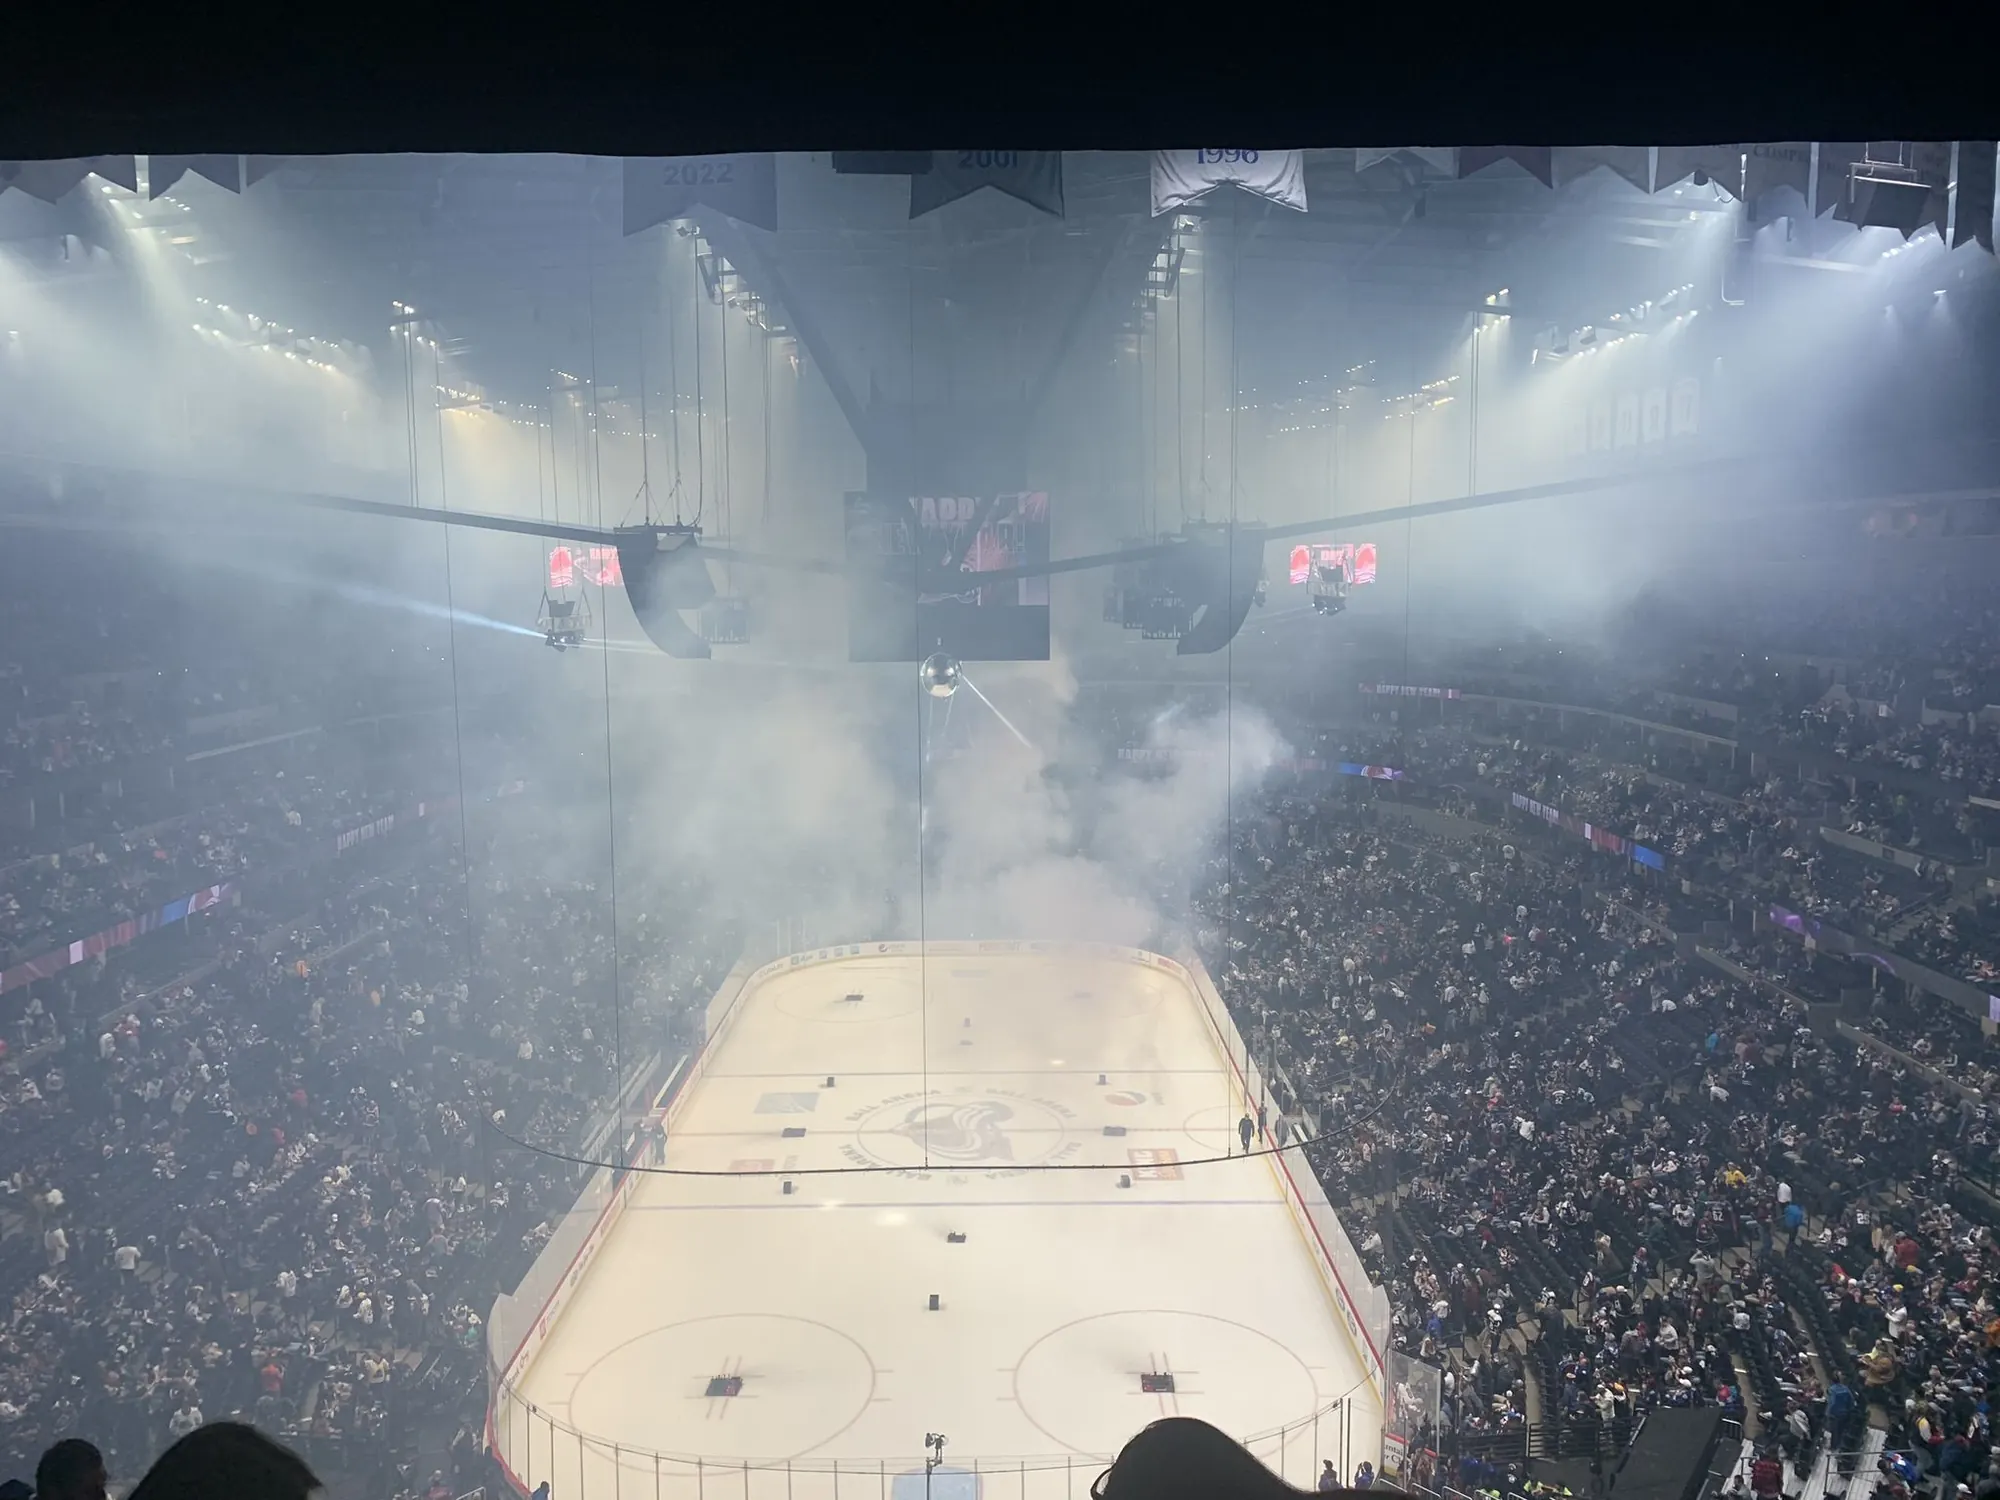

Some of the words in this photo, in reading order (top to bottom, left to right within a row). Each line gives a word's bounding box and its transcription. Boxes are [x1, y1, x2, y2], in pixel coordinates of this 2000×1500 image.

[957, 150, 1018, 170] 2001
[1197, 148, 1259, 164] 1996
[664, 162, 734, 186] 2022
